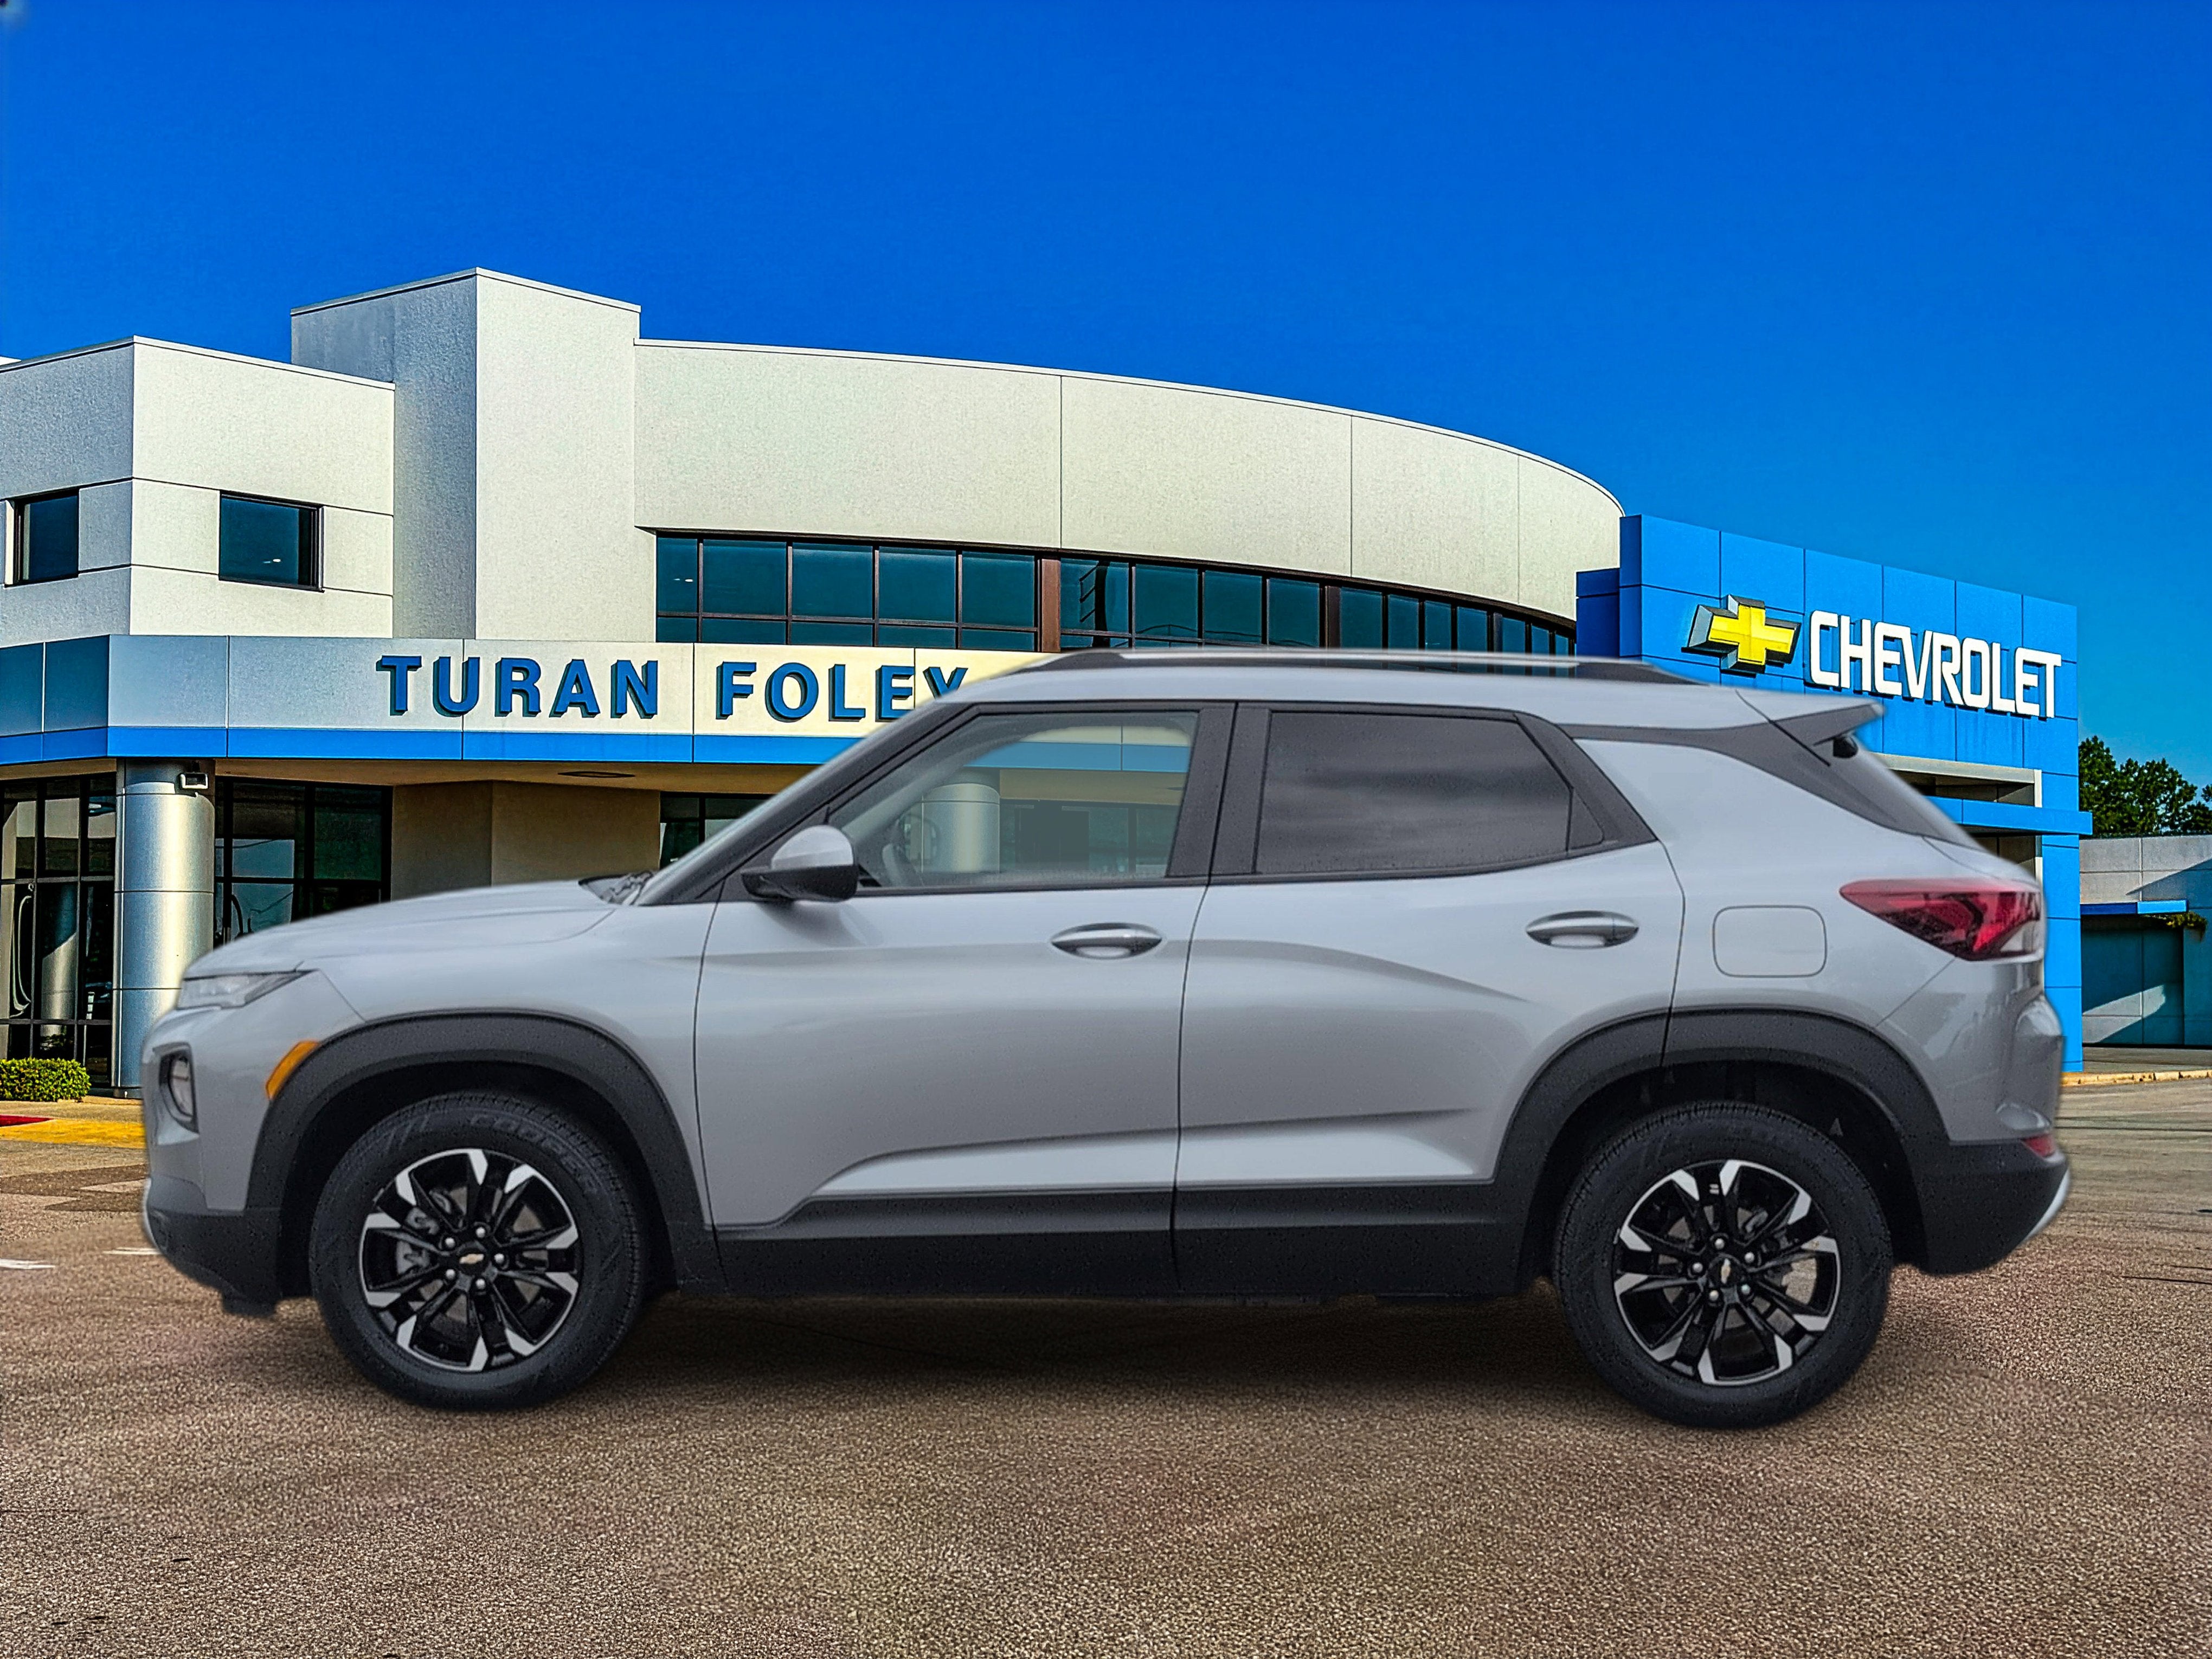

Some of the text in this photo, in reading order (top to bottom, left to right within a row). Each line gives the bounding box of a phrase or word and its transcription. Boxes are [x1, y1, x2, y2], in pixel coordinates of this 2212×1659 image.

[376, 655, 968, 723] TURAN FOLEY
[1809, 609, 2062, 719] CHEVROLET
[469, 1113, 599, 1195] COOPER
